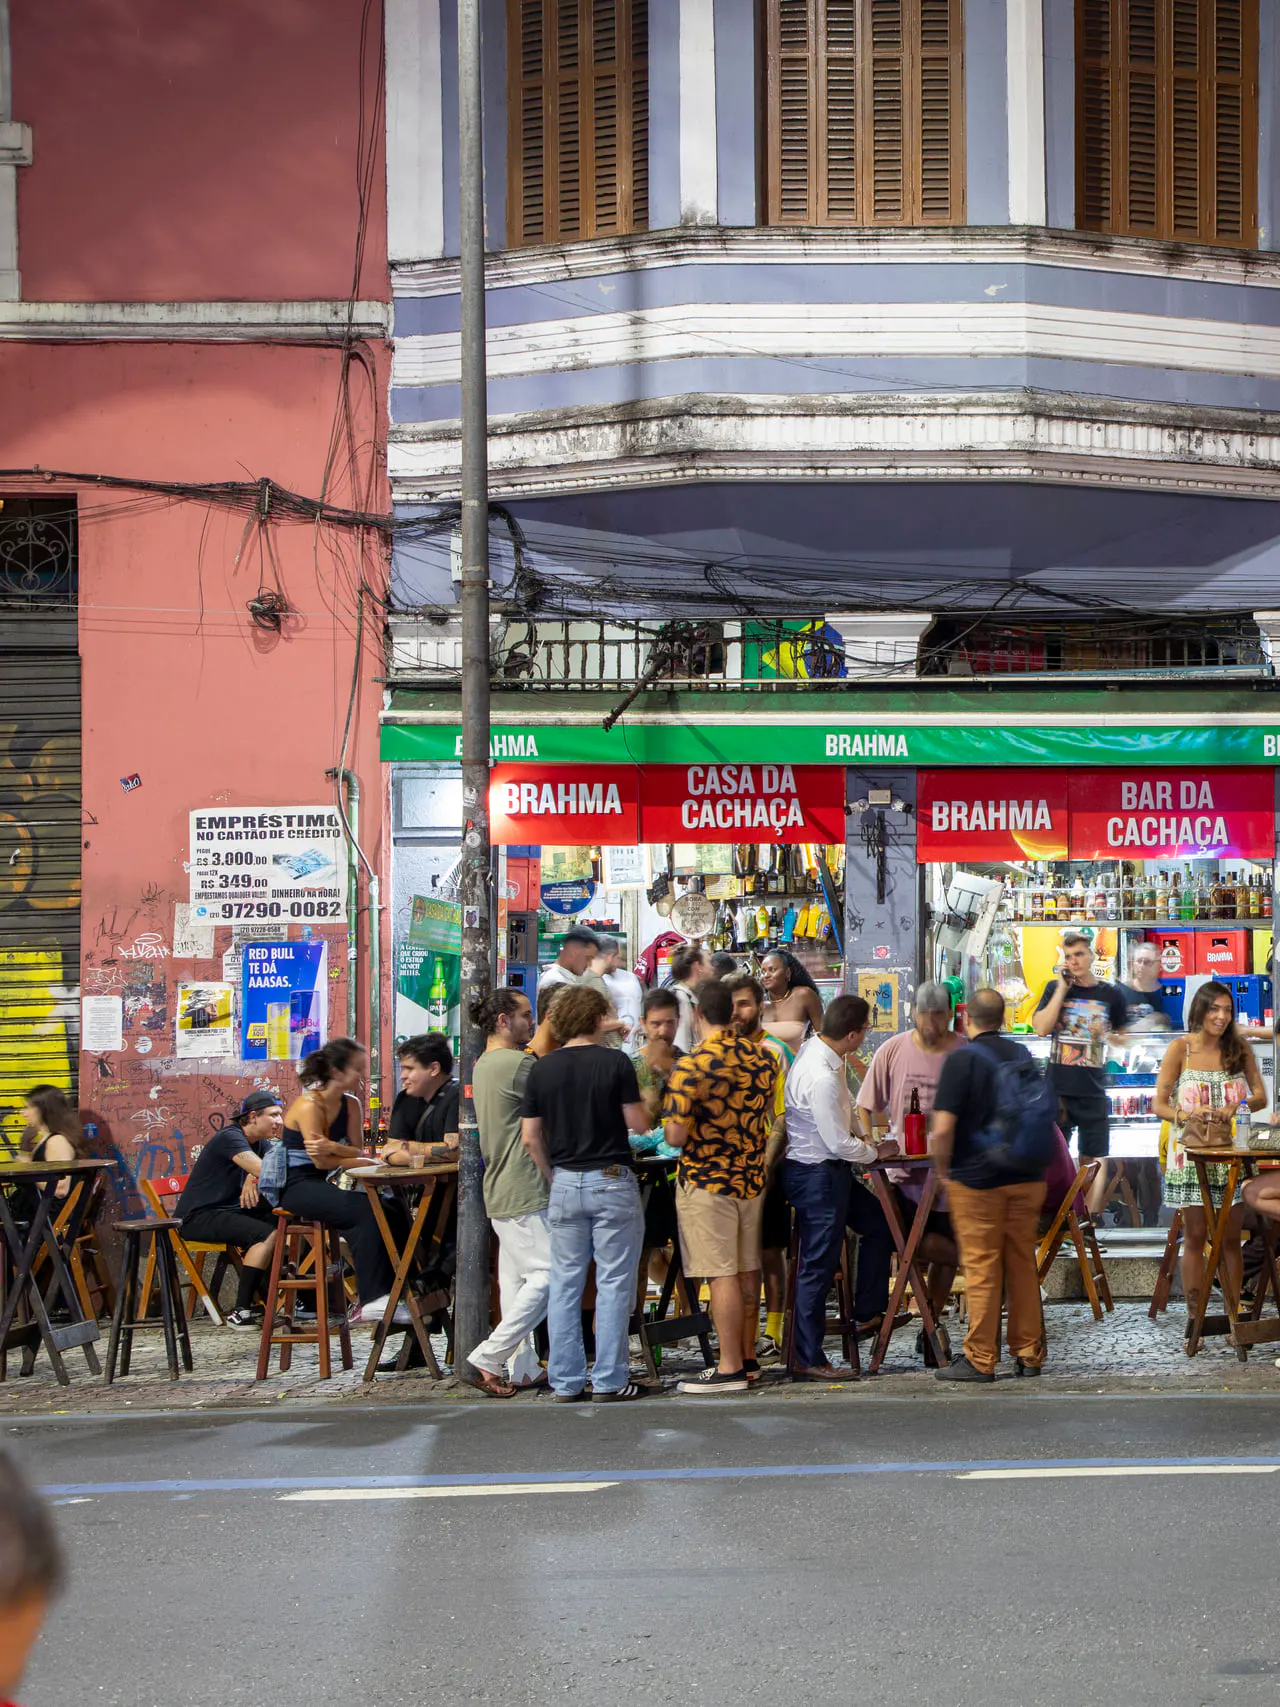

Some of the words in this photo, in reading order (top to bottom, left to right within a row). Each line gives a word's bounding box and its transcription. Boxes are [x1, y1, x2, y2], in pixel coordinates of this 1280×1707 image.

[825, 734, 909, 756] BRAHMA
[687, 765, 755, 795] CASA
[762, 765, 797, 794] DA
[501, 783, 622, 814] BRAHMA
[1121, 781, 1173, 810] BAR
[1179, 780, 1214, 809] DA
[196, 813, 339, 830] EMPRÉSTIMO
[681, 798, 805, 836] CACHAÇA
[932, 800, 1052, 831] BRAHMA
[196, 831, 214, 841] NO
[217, 828, 267, 840] CARTÃO
[270, 829, 285, 839] DE
[287, 828, 341, 839] CRÉDITO
[1107, 816, 1229, 853] CACHAÇA
[201, 879, 215, 889] R$
[219, 874, 268, 889] 349,00
[271, 889, 305, 898] DINHEIRO
[221, 901, 341, 919] 97290-0082
[248, 948, 268, 960] RED
[270, 947, 295, 959] BULL
[1207, 952, 1233, 963] BRAHMA
[248, 963, 260, 974] TE
[262, 960, 278, 974] DÁ
[248, 975, 292, 988] AAASAS.
